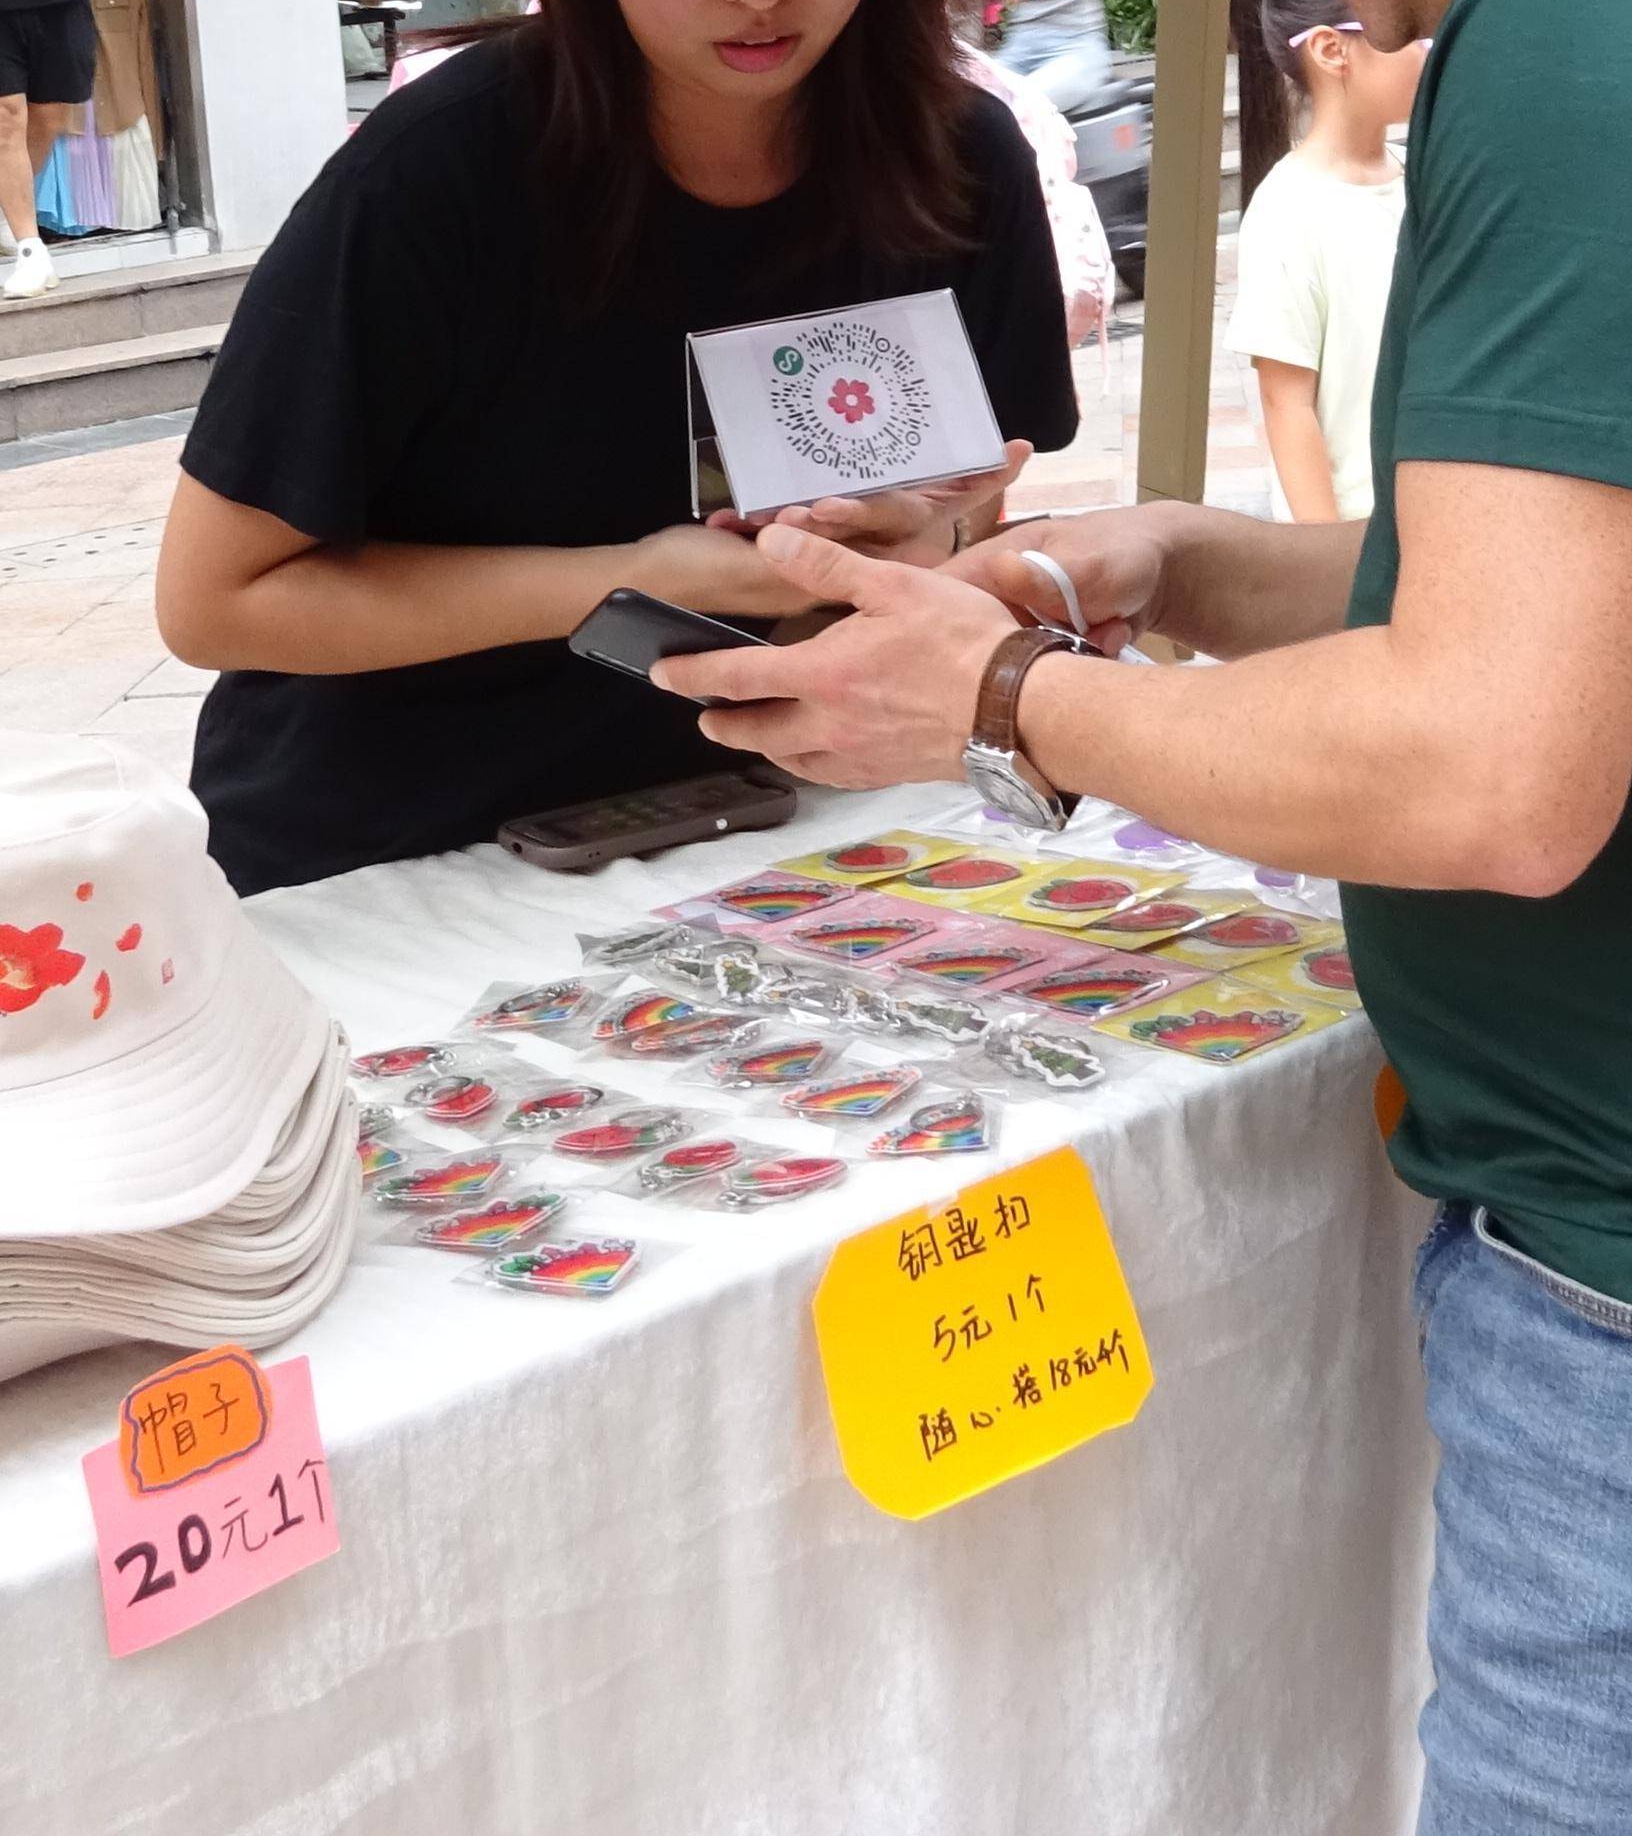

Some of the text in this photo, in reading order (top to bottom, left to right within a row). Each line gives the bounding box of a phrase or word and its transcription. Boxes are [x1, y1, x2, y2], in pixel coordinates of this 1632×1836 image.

[897, 1194, 1032, 1281] 钥匙扣
[138, 1382, 241, 1475] 帽子
[113, 1458, 326, 1609] 20元1个
